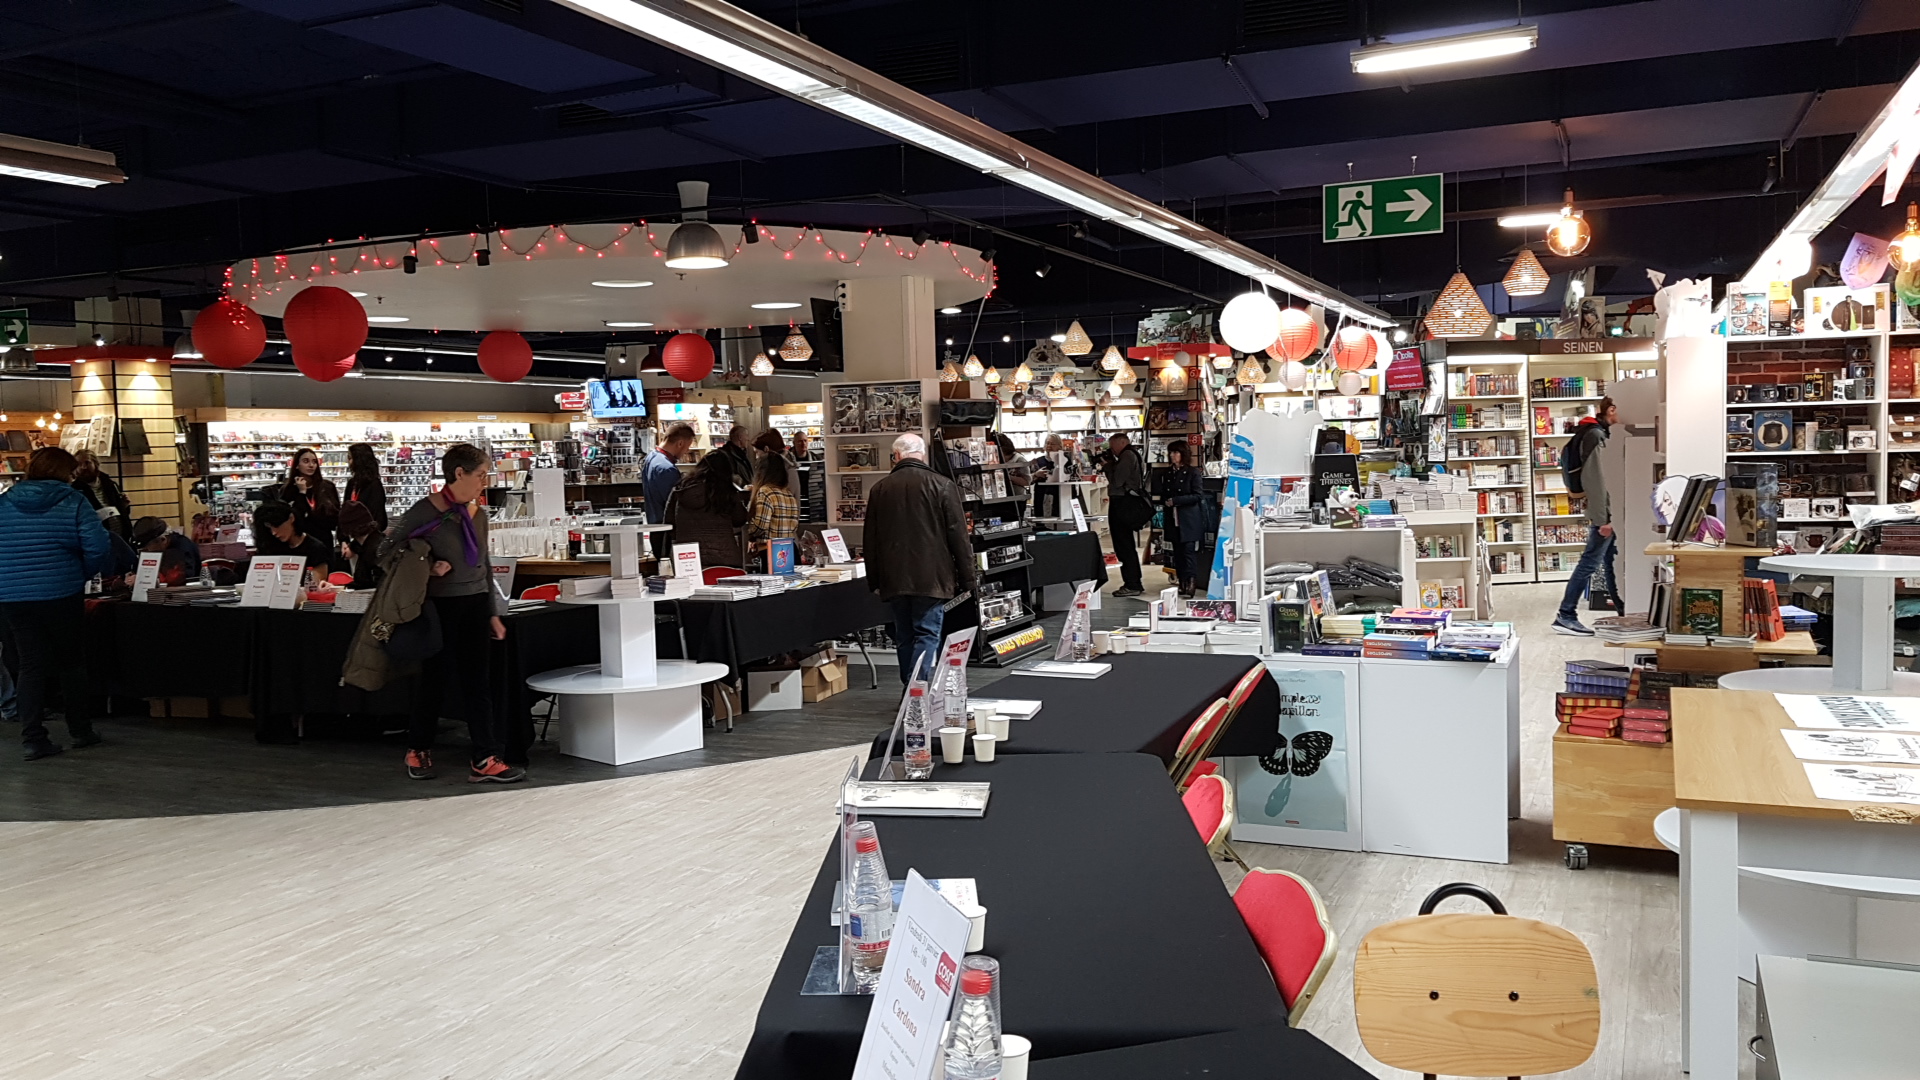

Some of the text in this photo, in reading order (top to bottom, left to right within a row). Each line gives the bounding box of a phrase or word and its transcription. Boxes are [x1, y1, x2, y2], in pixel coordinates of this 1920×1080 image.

[1562, 341, 1604, 354] SEINEN
[1319, 477, 1355, 486] THRONES
[1322, 471, 1344, 479] GAME
[1280, 705, 1321, 719] apillon
[903, 967, 926, 1001] Sandra
[892, 998, 918, 1038] Cardona
